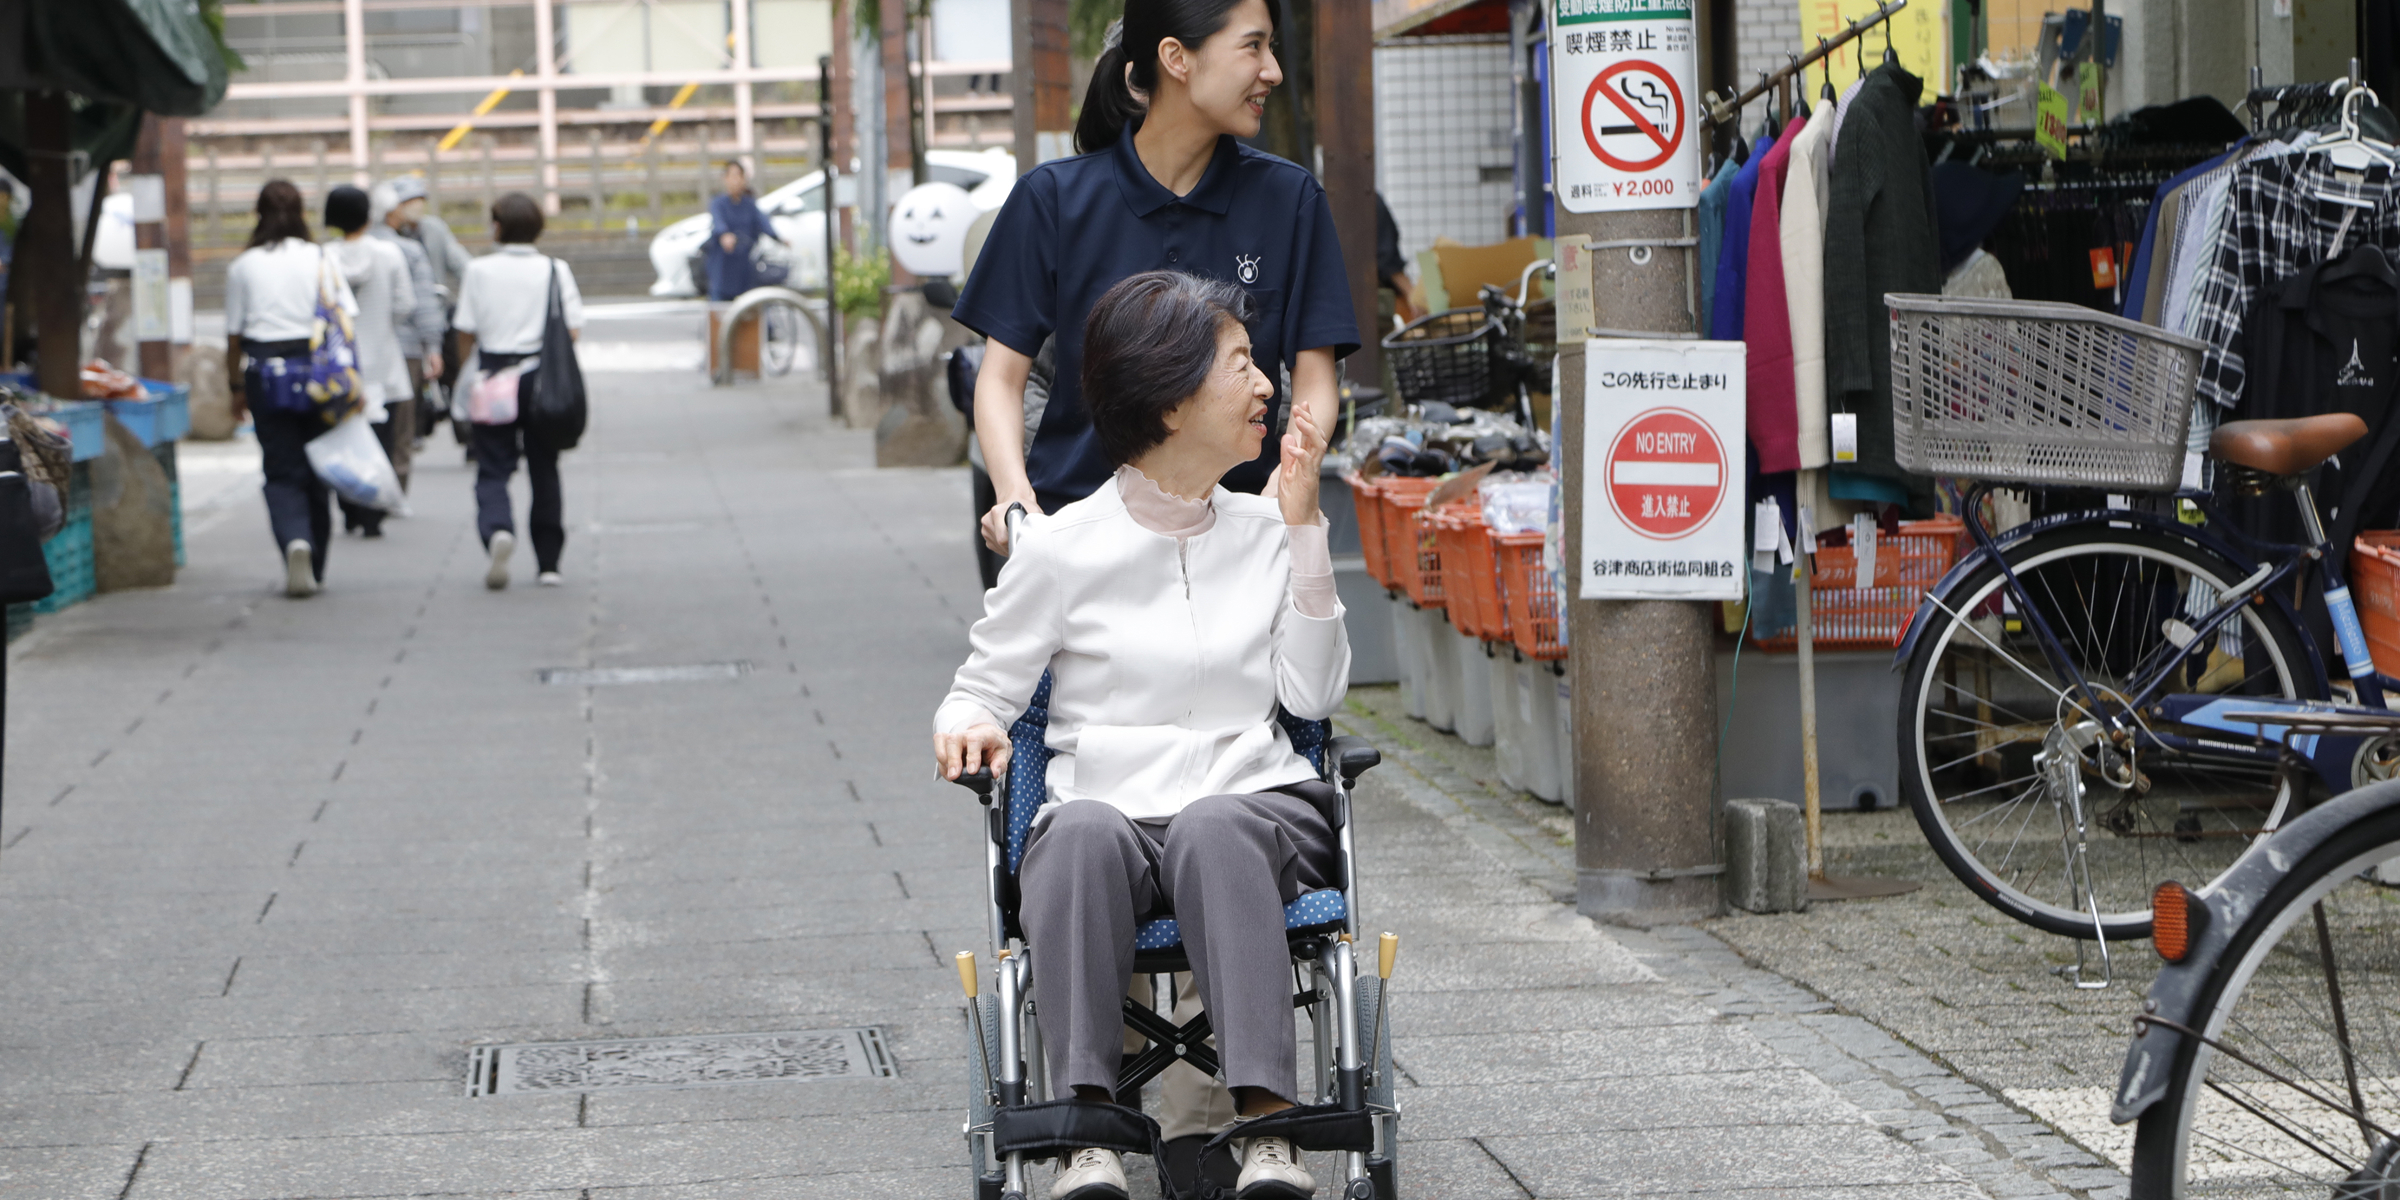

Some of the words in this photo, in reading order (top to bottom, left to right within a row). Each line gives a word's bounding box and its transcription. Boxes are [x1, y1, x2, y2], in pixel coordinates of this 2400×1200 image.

[1566, 28, 1657, 55] 喫煙禁止
[1602, 371, 1727, 390] この先行き止まり
[1636, 432, 1654, 454] NO
[1657, 432, 1697, 455] ENTRY
[1641, 494, 1691, 518] 進入禁止
[1593, 559, 1735, 578] 谷津商店街協同組合
